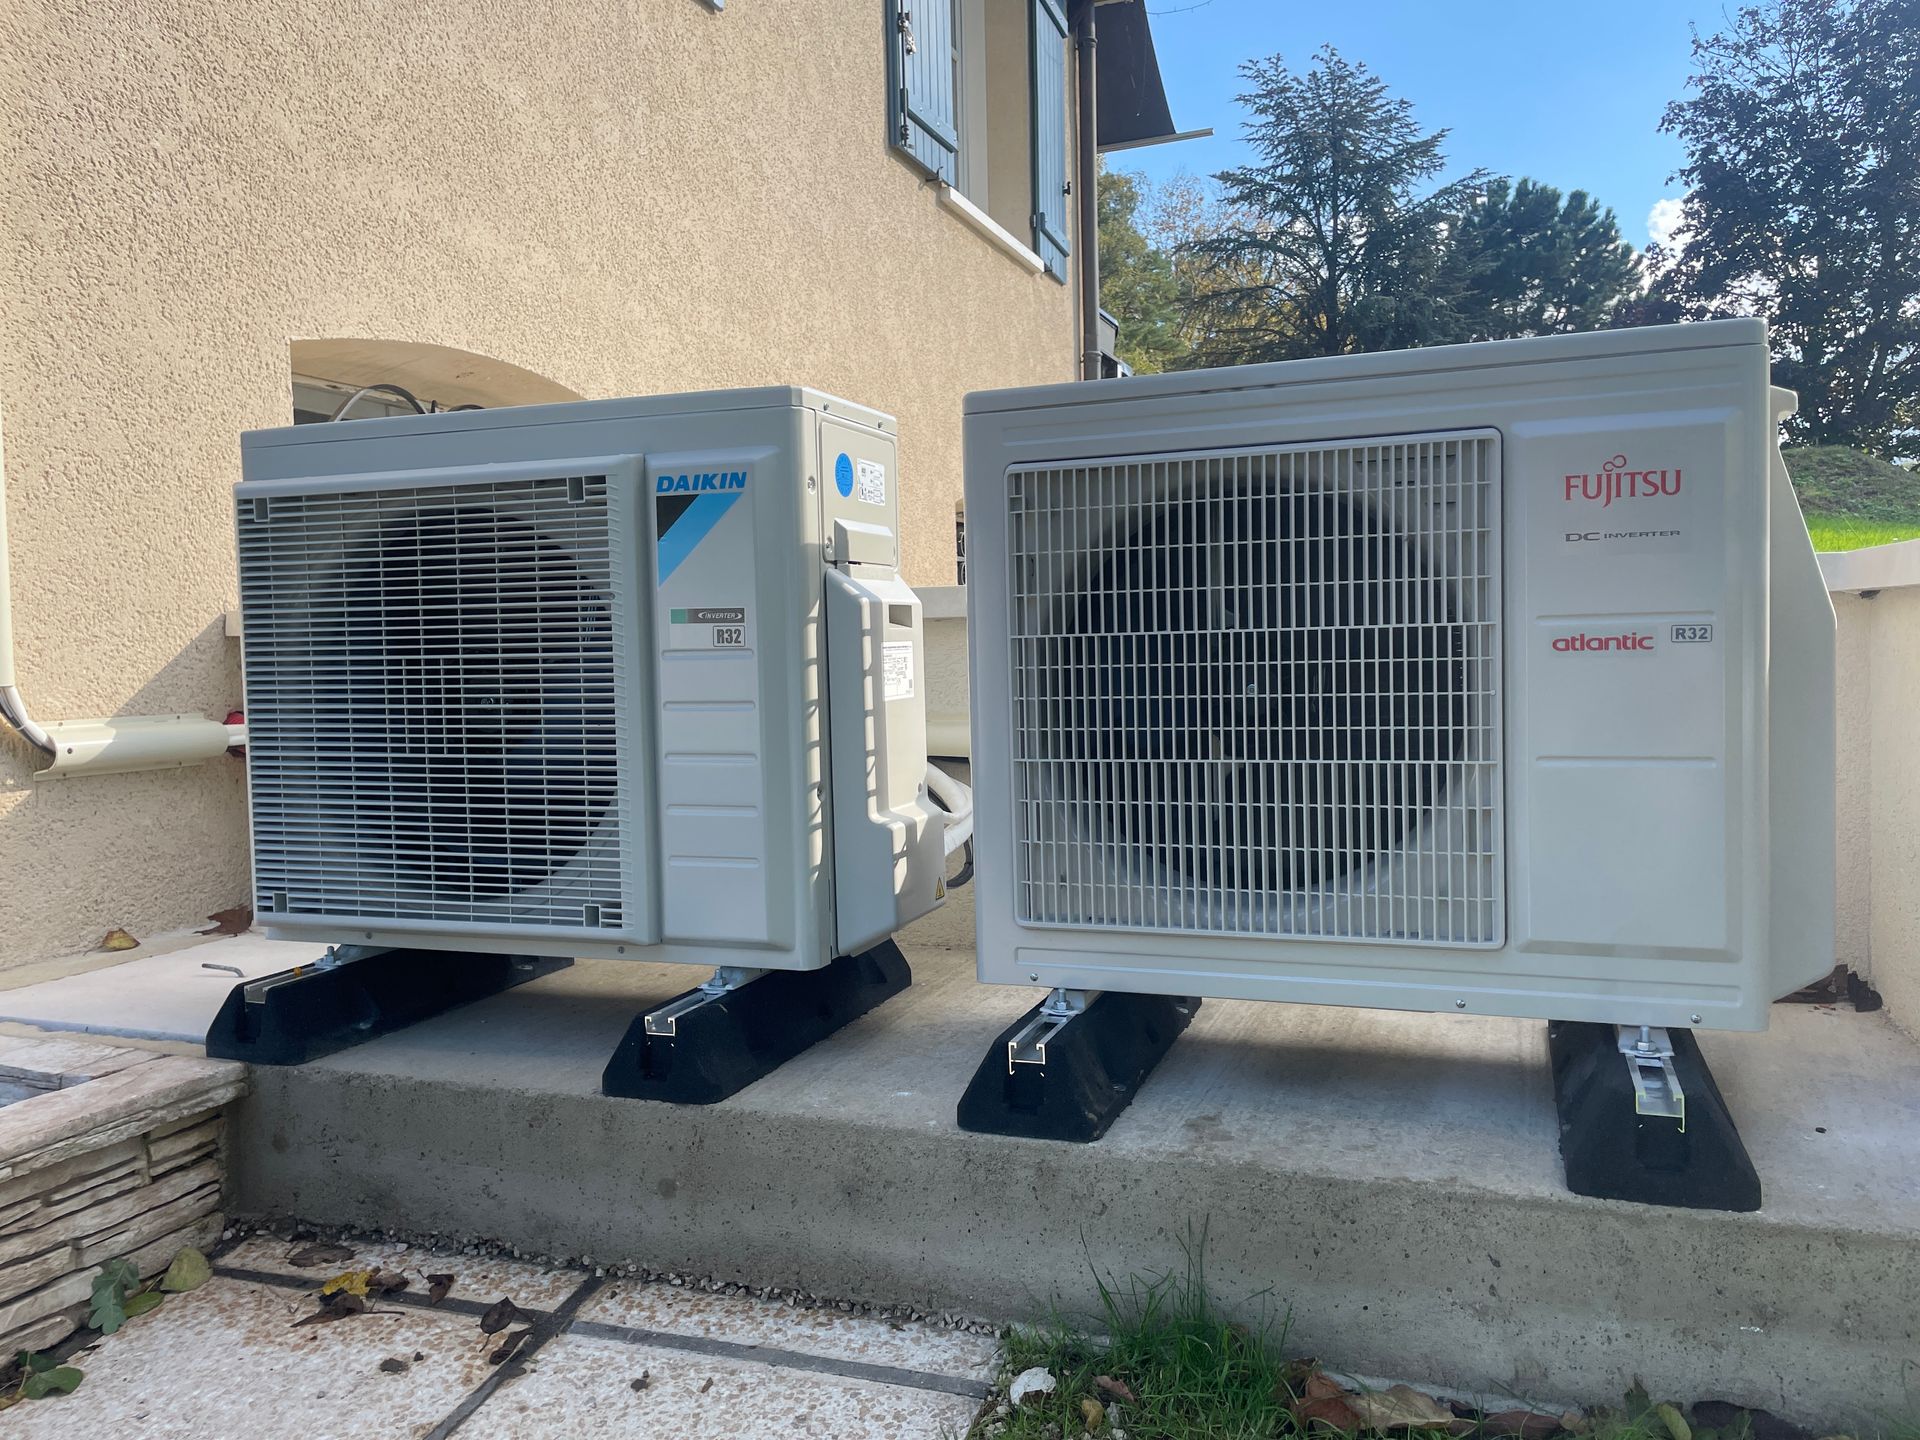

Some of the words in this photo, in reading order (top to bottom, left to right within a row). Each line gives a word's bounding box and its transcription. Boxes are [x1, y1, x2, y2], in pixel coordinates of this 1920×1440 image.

[656, 472, 747, 492] DAIKIN
[1565, 454, 1681, 508] FUJITSU
[1565, 532, 1600, 542] DC
[1604, 530, 1680, 539] INVERTER
[704, 612, 736, 620] INVERTER
[716, 628, 742, 644] R32
[1674, 627, 1708, 640] R32
[1552, 632, 1654, 652] atlantic
